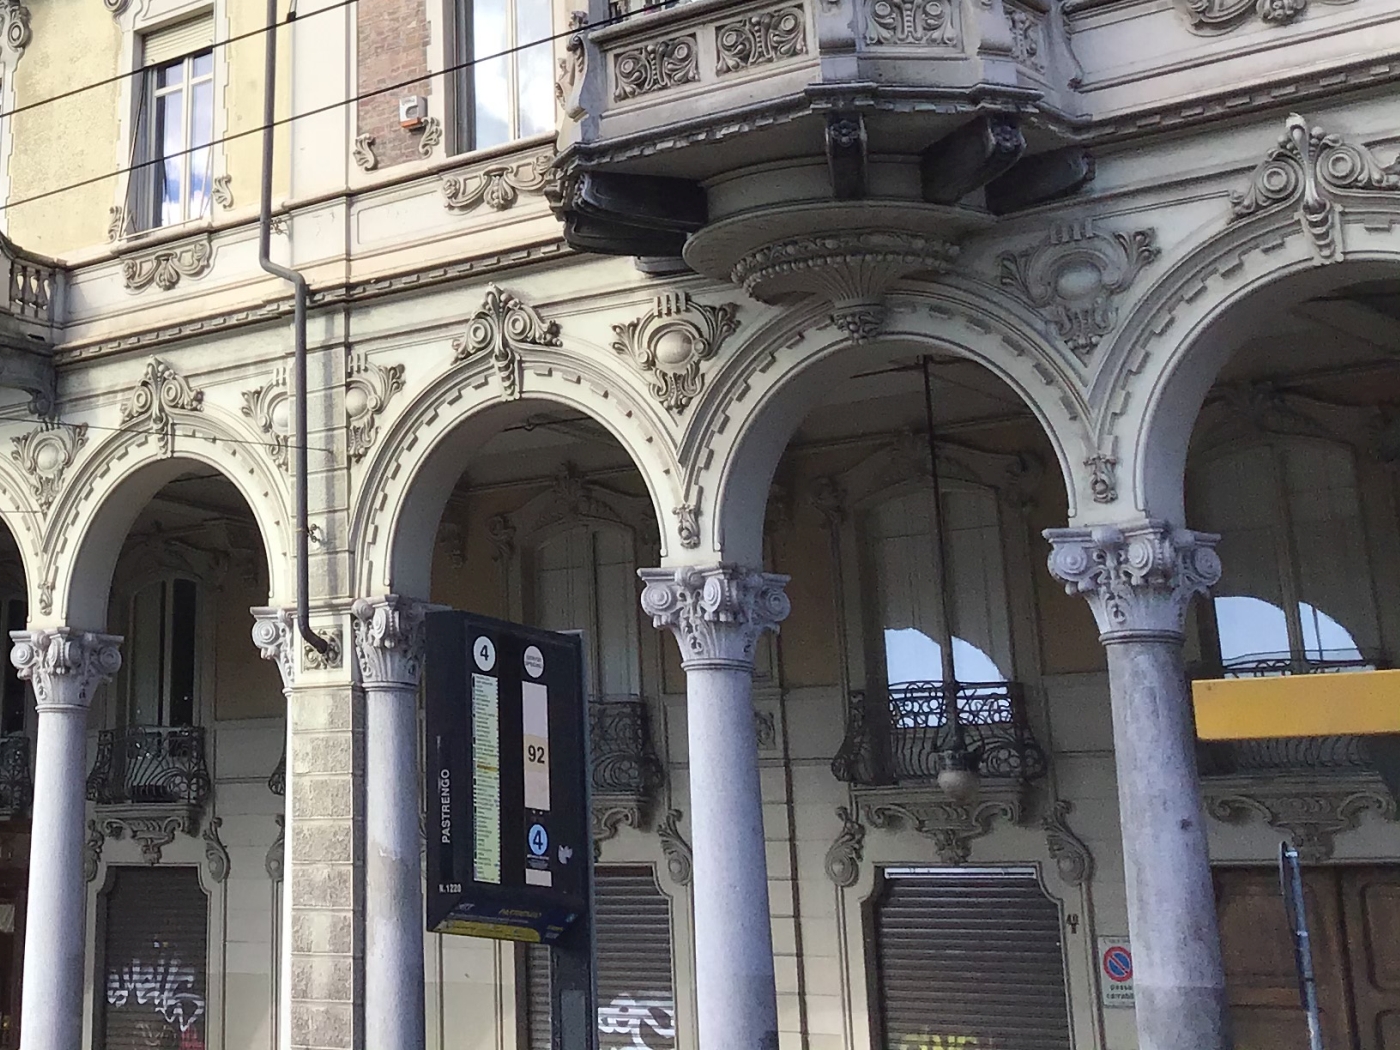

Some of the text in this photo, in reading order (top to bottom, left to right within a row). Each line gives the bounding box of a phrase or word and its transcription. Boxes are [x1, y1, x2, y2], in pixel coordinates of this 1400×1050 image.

[480, 645, 489, 661] 4
[528, 745, 545, 764] 92
[441, 769, 451, 843] PASTRENGO
[533, 830, 543, 850] 4
